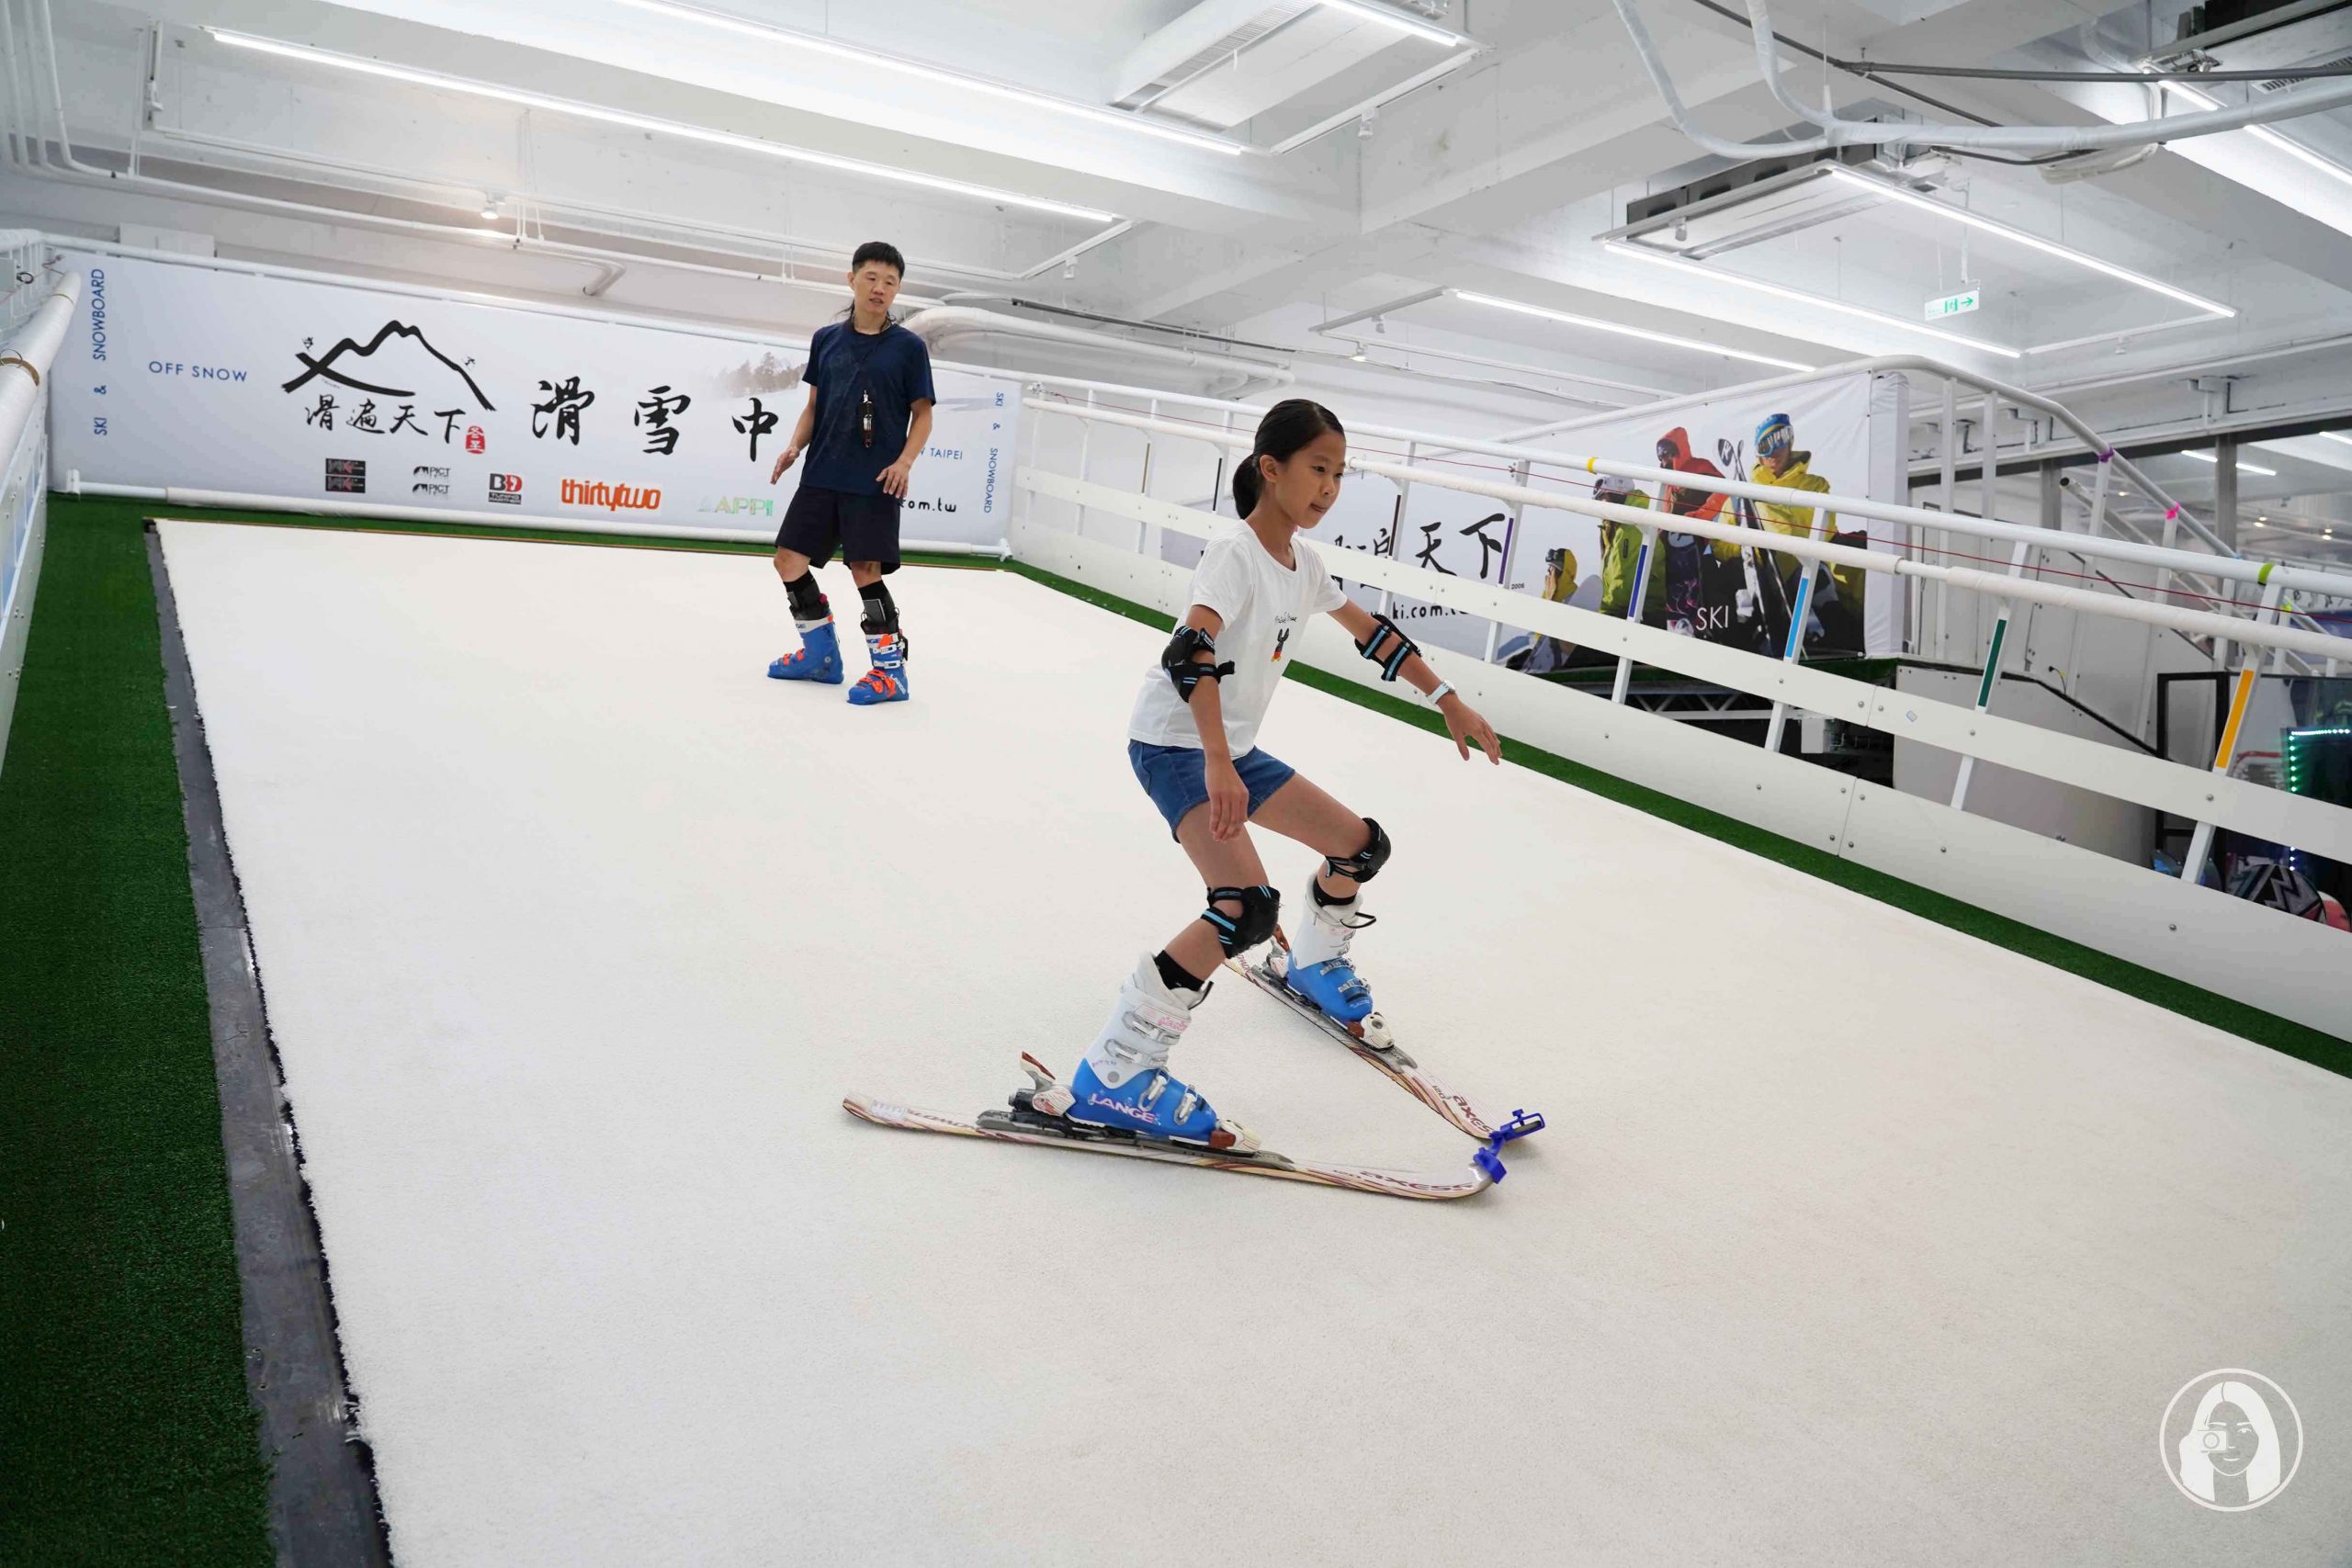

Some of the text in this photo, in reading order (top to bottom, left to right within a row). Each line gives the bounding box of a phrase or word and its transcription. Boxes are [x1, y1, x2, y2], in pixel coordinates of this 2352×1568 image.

[91, 268, 107, 436] SKI & SNOWBOARD
[149, 361, 247, 382] OFF SNOW
[995, 392, 1004, 406] SKI
[930, 447, 963, 460] TAIPEI
[561, 479, 662, 511] thirtytwo
[983, 447, 999, 513] SNOWBOARD
[1696, 605, 1729, 631] SKI
[1091, 1093, 1156, 1123] LANGE
[1453, 1095, 1494, 1133] axes
